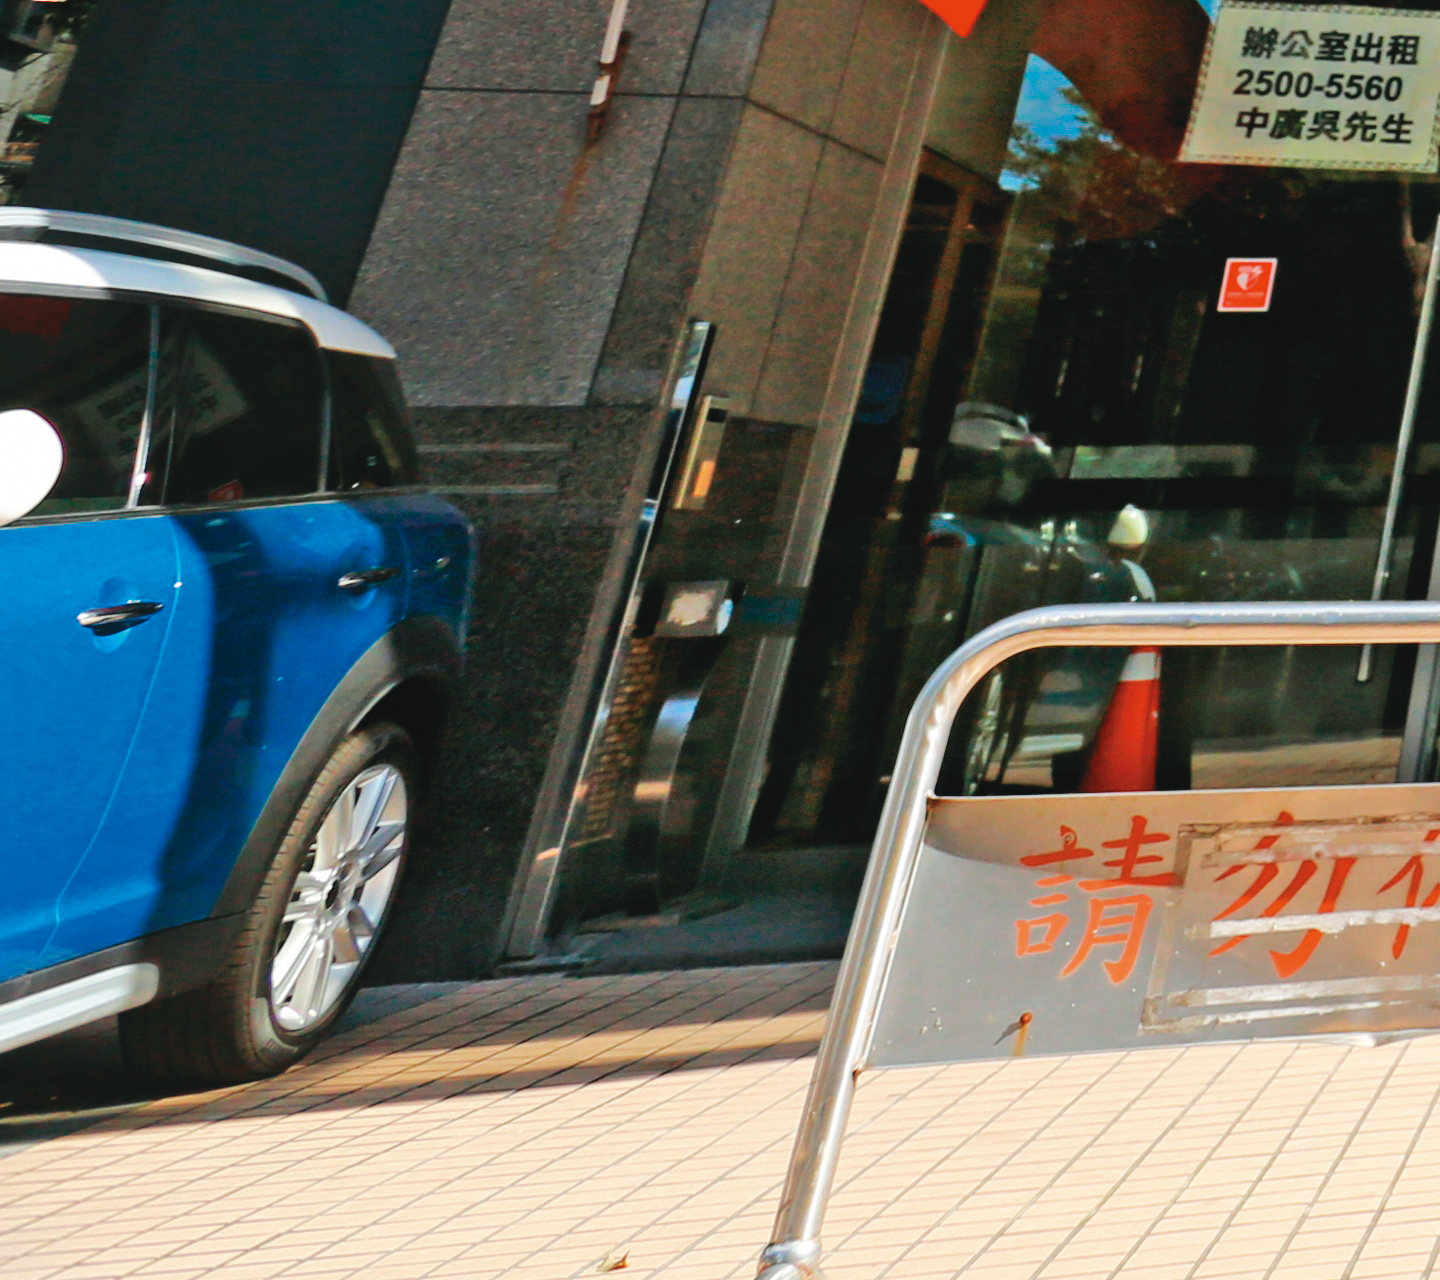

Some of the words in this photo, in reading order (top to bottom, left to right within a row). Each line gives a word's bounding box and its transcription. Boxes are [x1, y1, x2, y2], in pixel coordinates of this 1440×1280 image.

[1241, 26, 1420, 66] 辦公室出租
[1233, 69, 1403, 102] 2500-5560
[1235, 107, 1414, 144] 中廣吳先生
